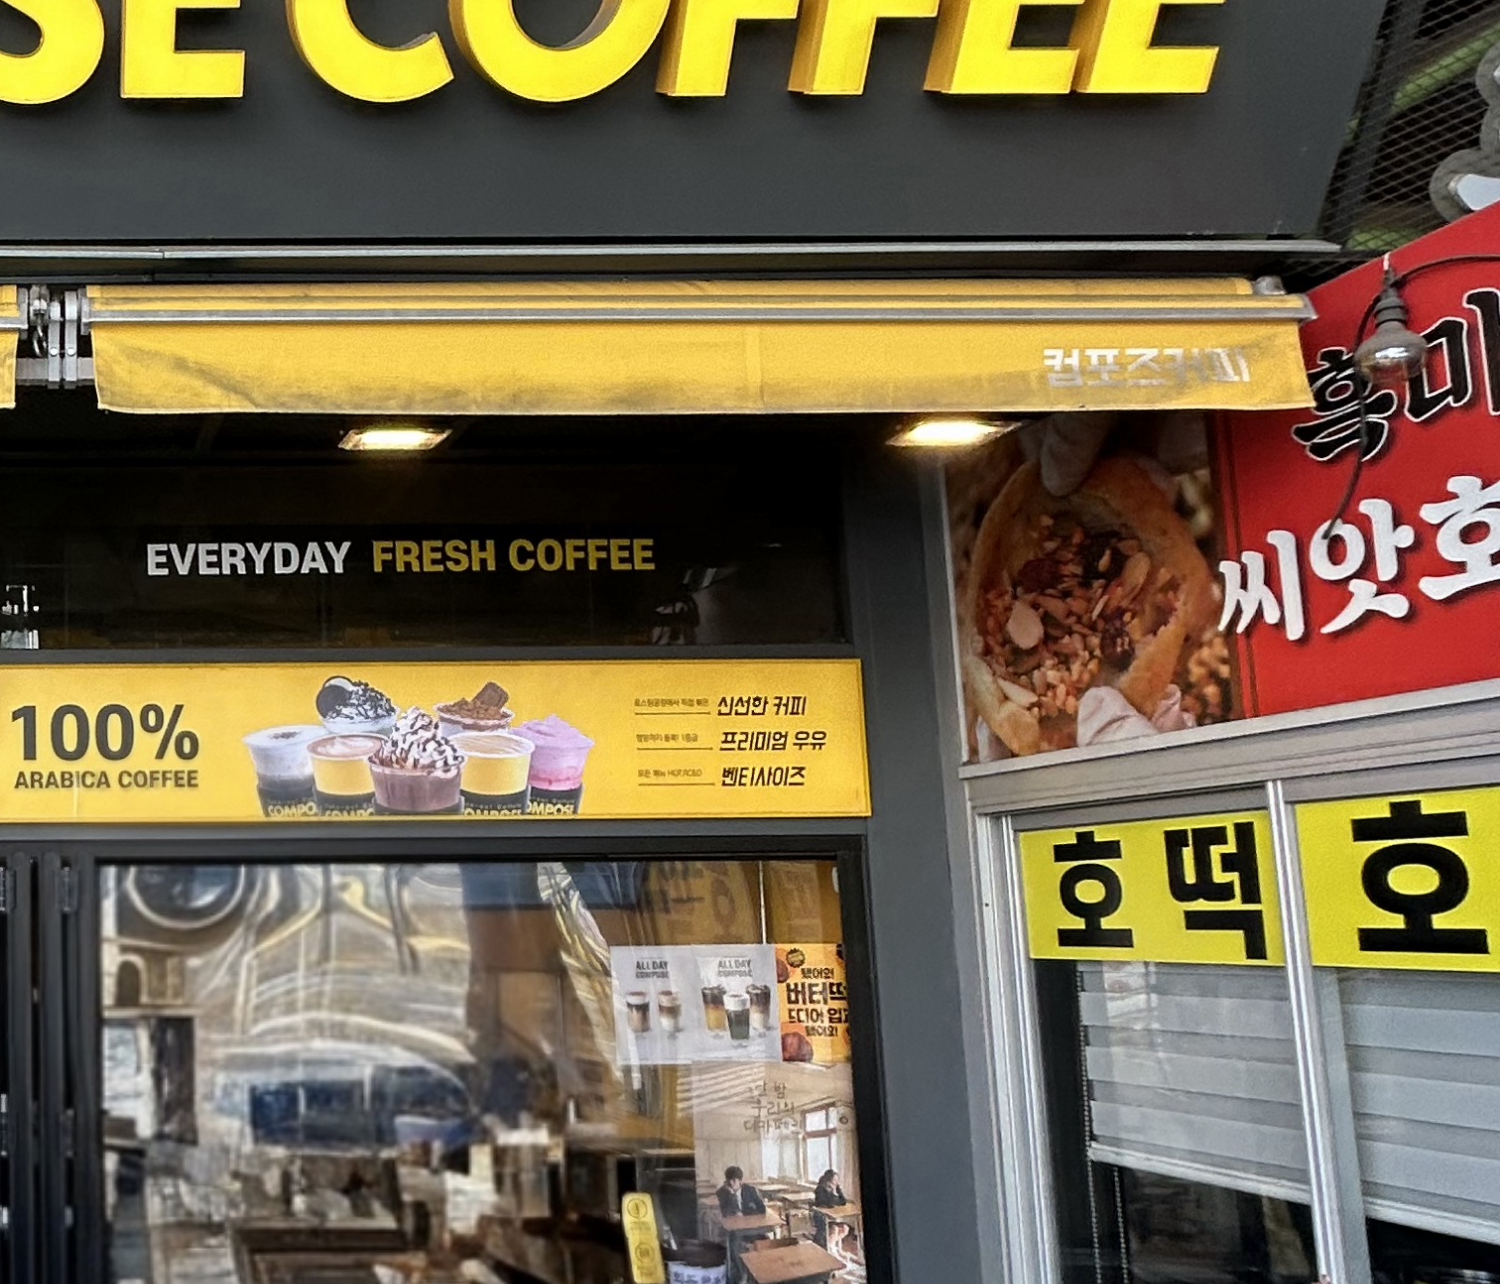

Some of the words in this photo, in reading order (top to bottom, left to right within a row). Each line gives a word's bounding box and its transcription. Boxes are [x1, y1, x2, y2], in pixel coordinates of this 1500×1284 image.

[146, 540, 352, 576] EVERYDAY
[372, 539, 496, 573] FRESH
[508, 538, 656, 572] COFFEE
[717, 695, 769, 716] 신선한
[773, 695, 807, 716] 커피
[11, 703, 200, 762] 100%
[719, 730, 788, 751] 프리미엄
[792, 730, 828, 751] 우유
[14, 770, 111, 790] ARABICA
[118, 769, 200, 789] COFFEE
[721, 765, 807, 787] 벤티사이즈
[1351, 799, 1491, 955] 호
[1052, 829, 1270, 961] 호떡
[635, 960, 651, 970] ALL
[652, 960, 669, 970] DAY
